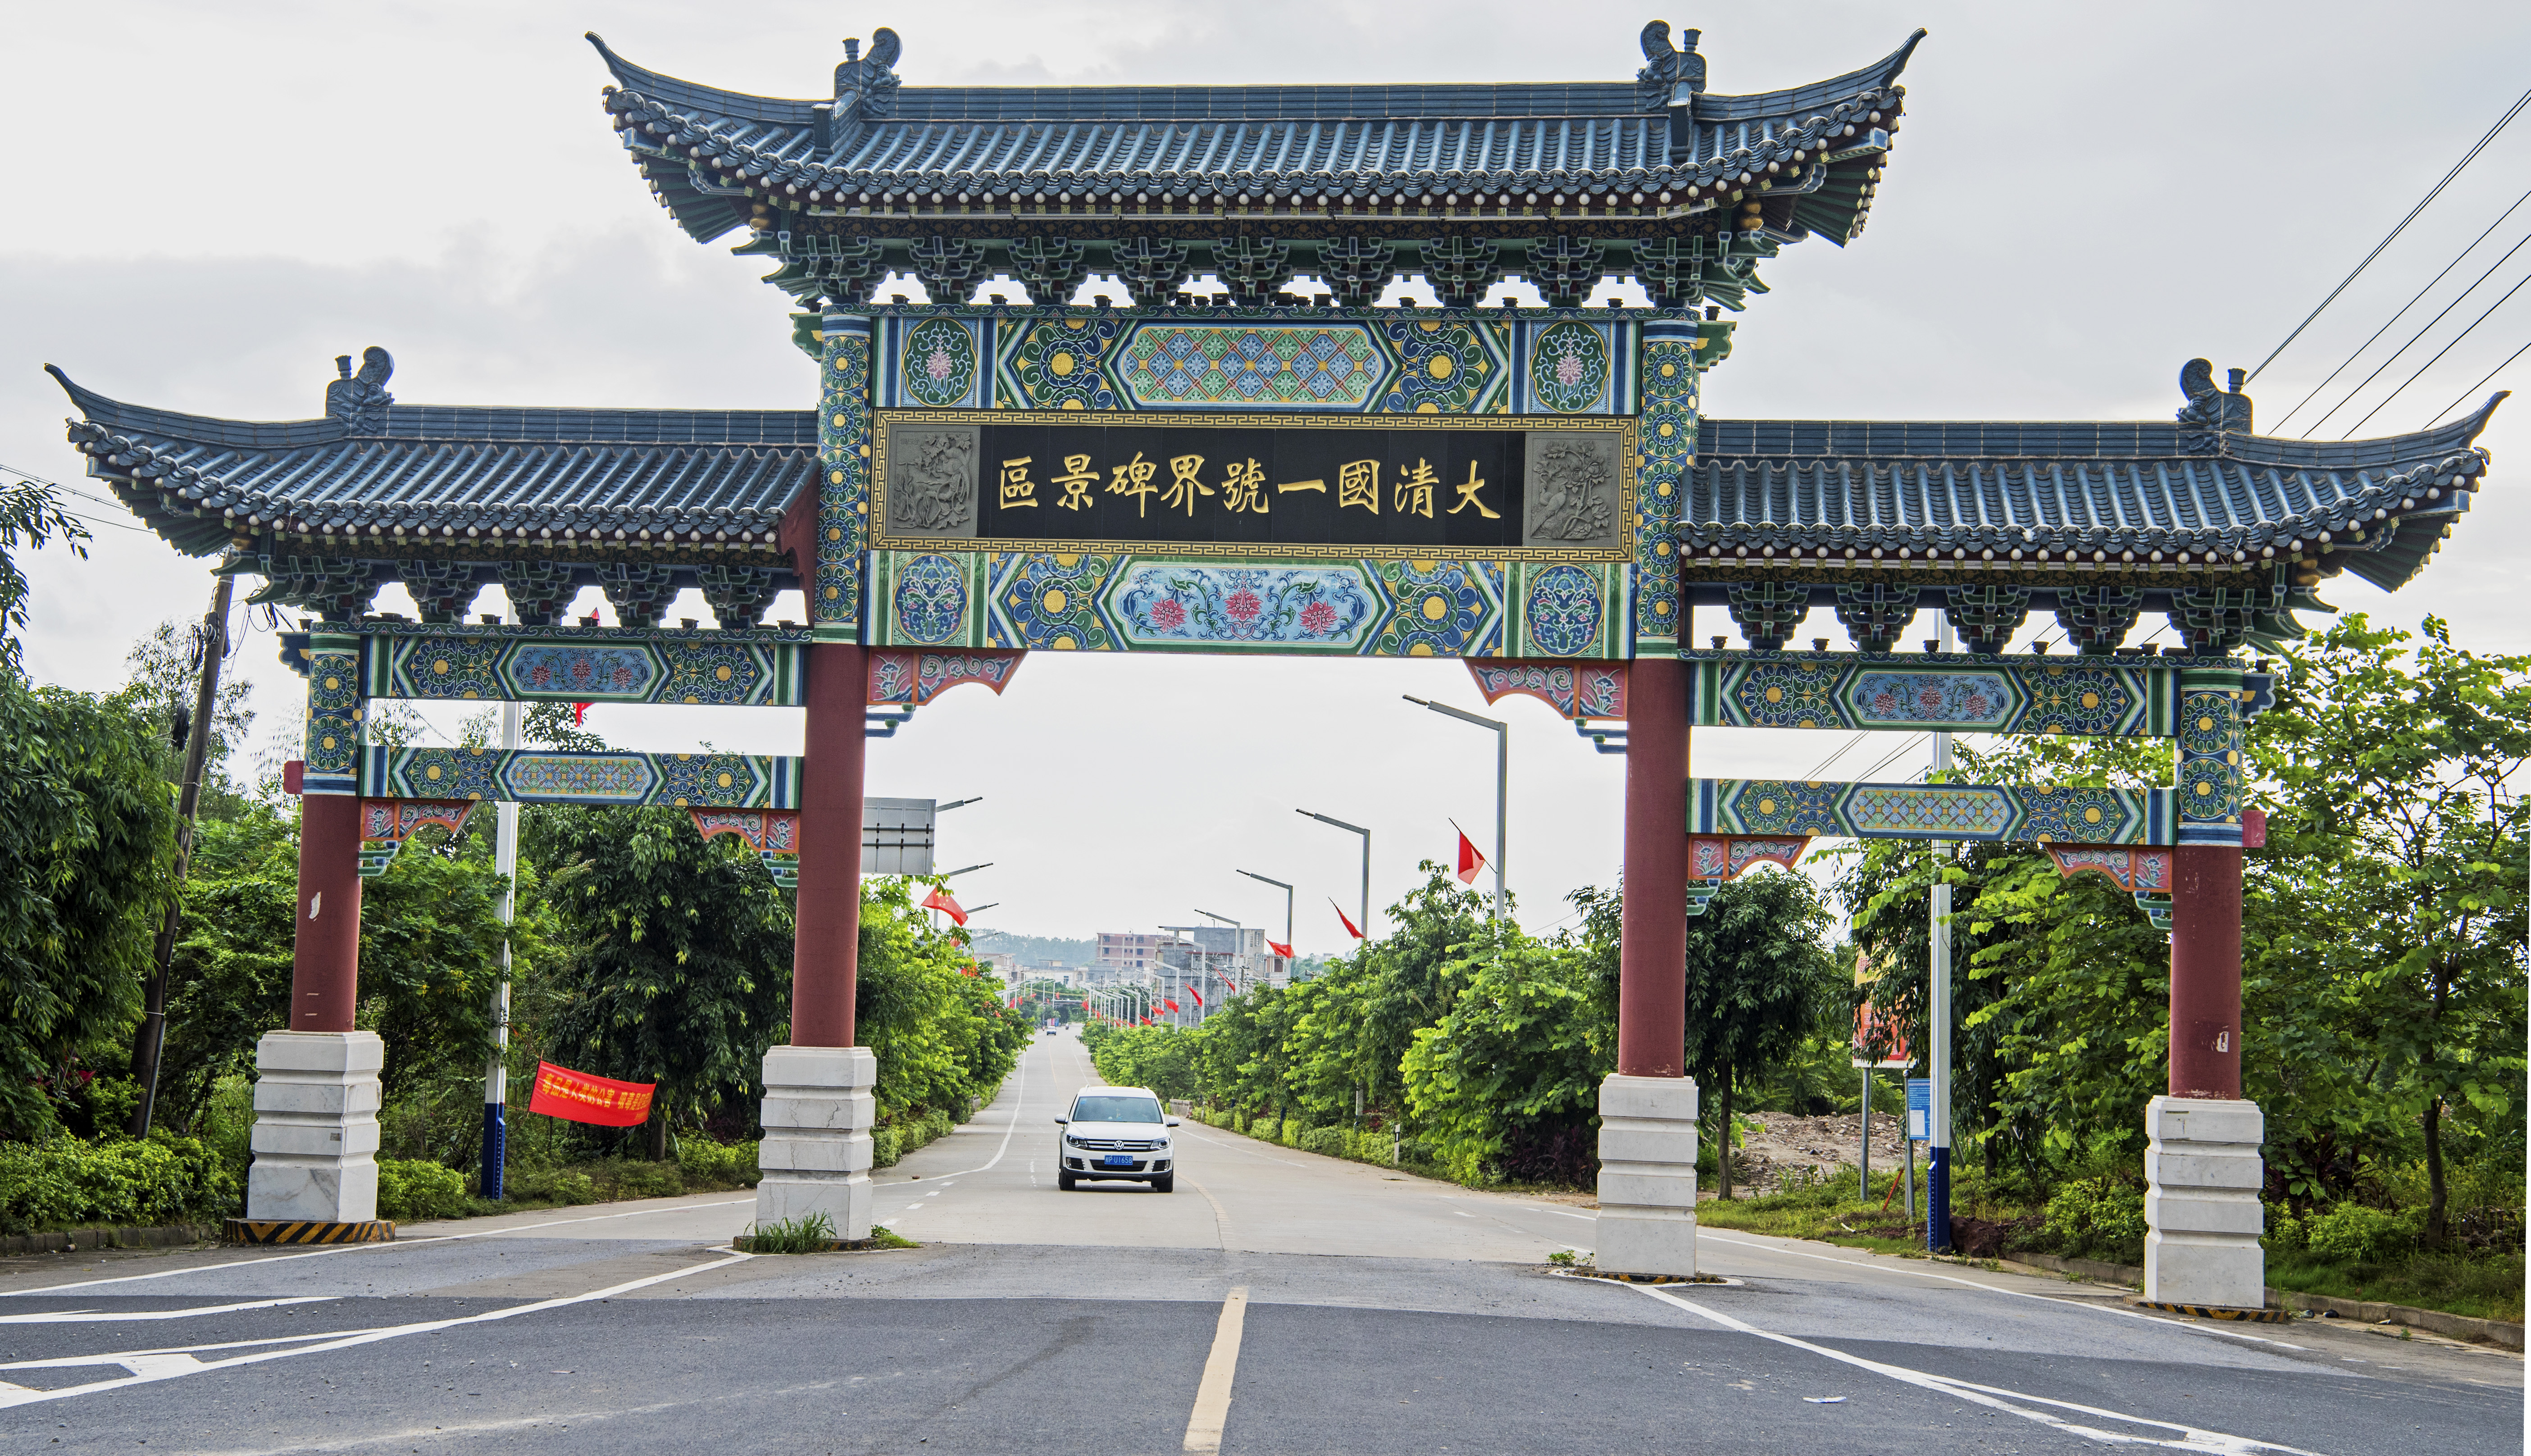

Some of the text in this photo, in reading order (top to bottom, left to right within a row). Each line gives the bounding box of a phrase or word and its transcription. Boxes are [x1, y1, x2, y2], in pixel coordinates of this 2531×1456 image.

[1000, 451, 1502, 519] 大清國一號界碑景區
[542, 1073, 615, 1108] 毒品是人类的公害
